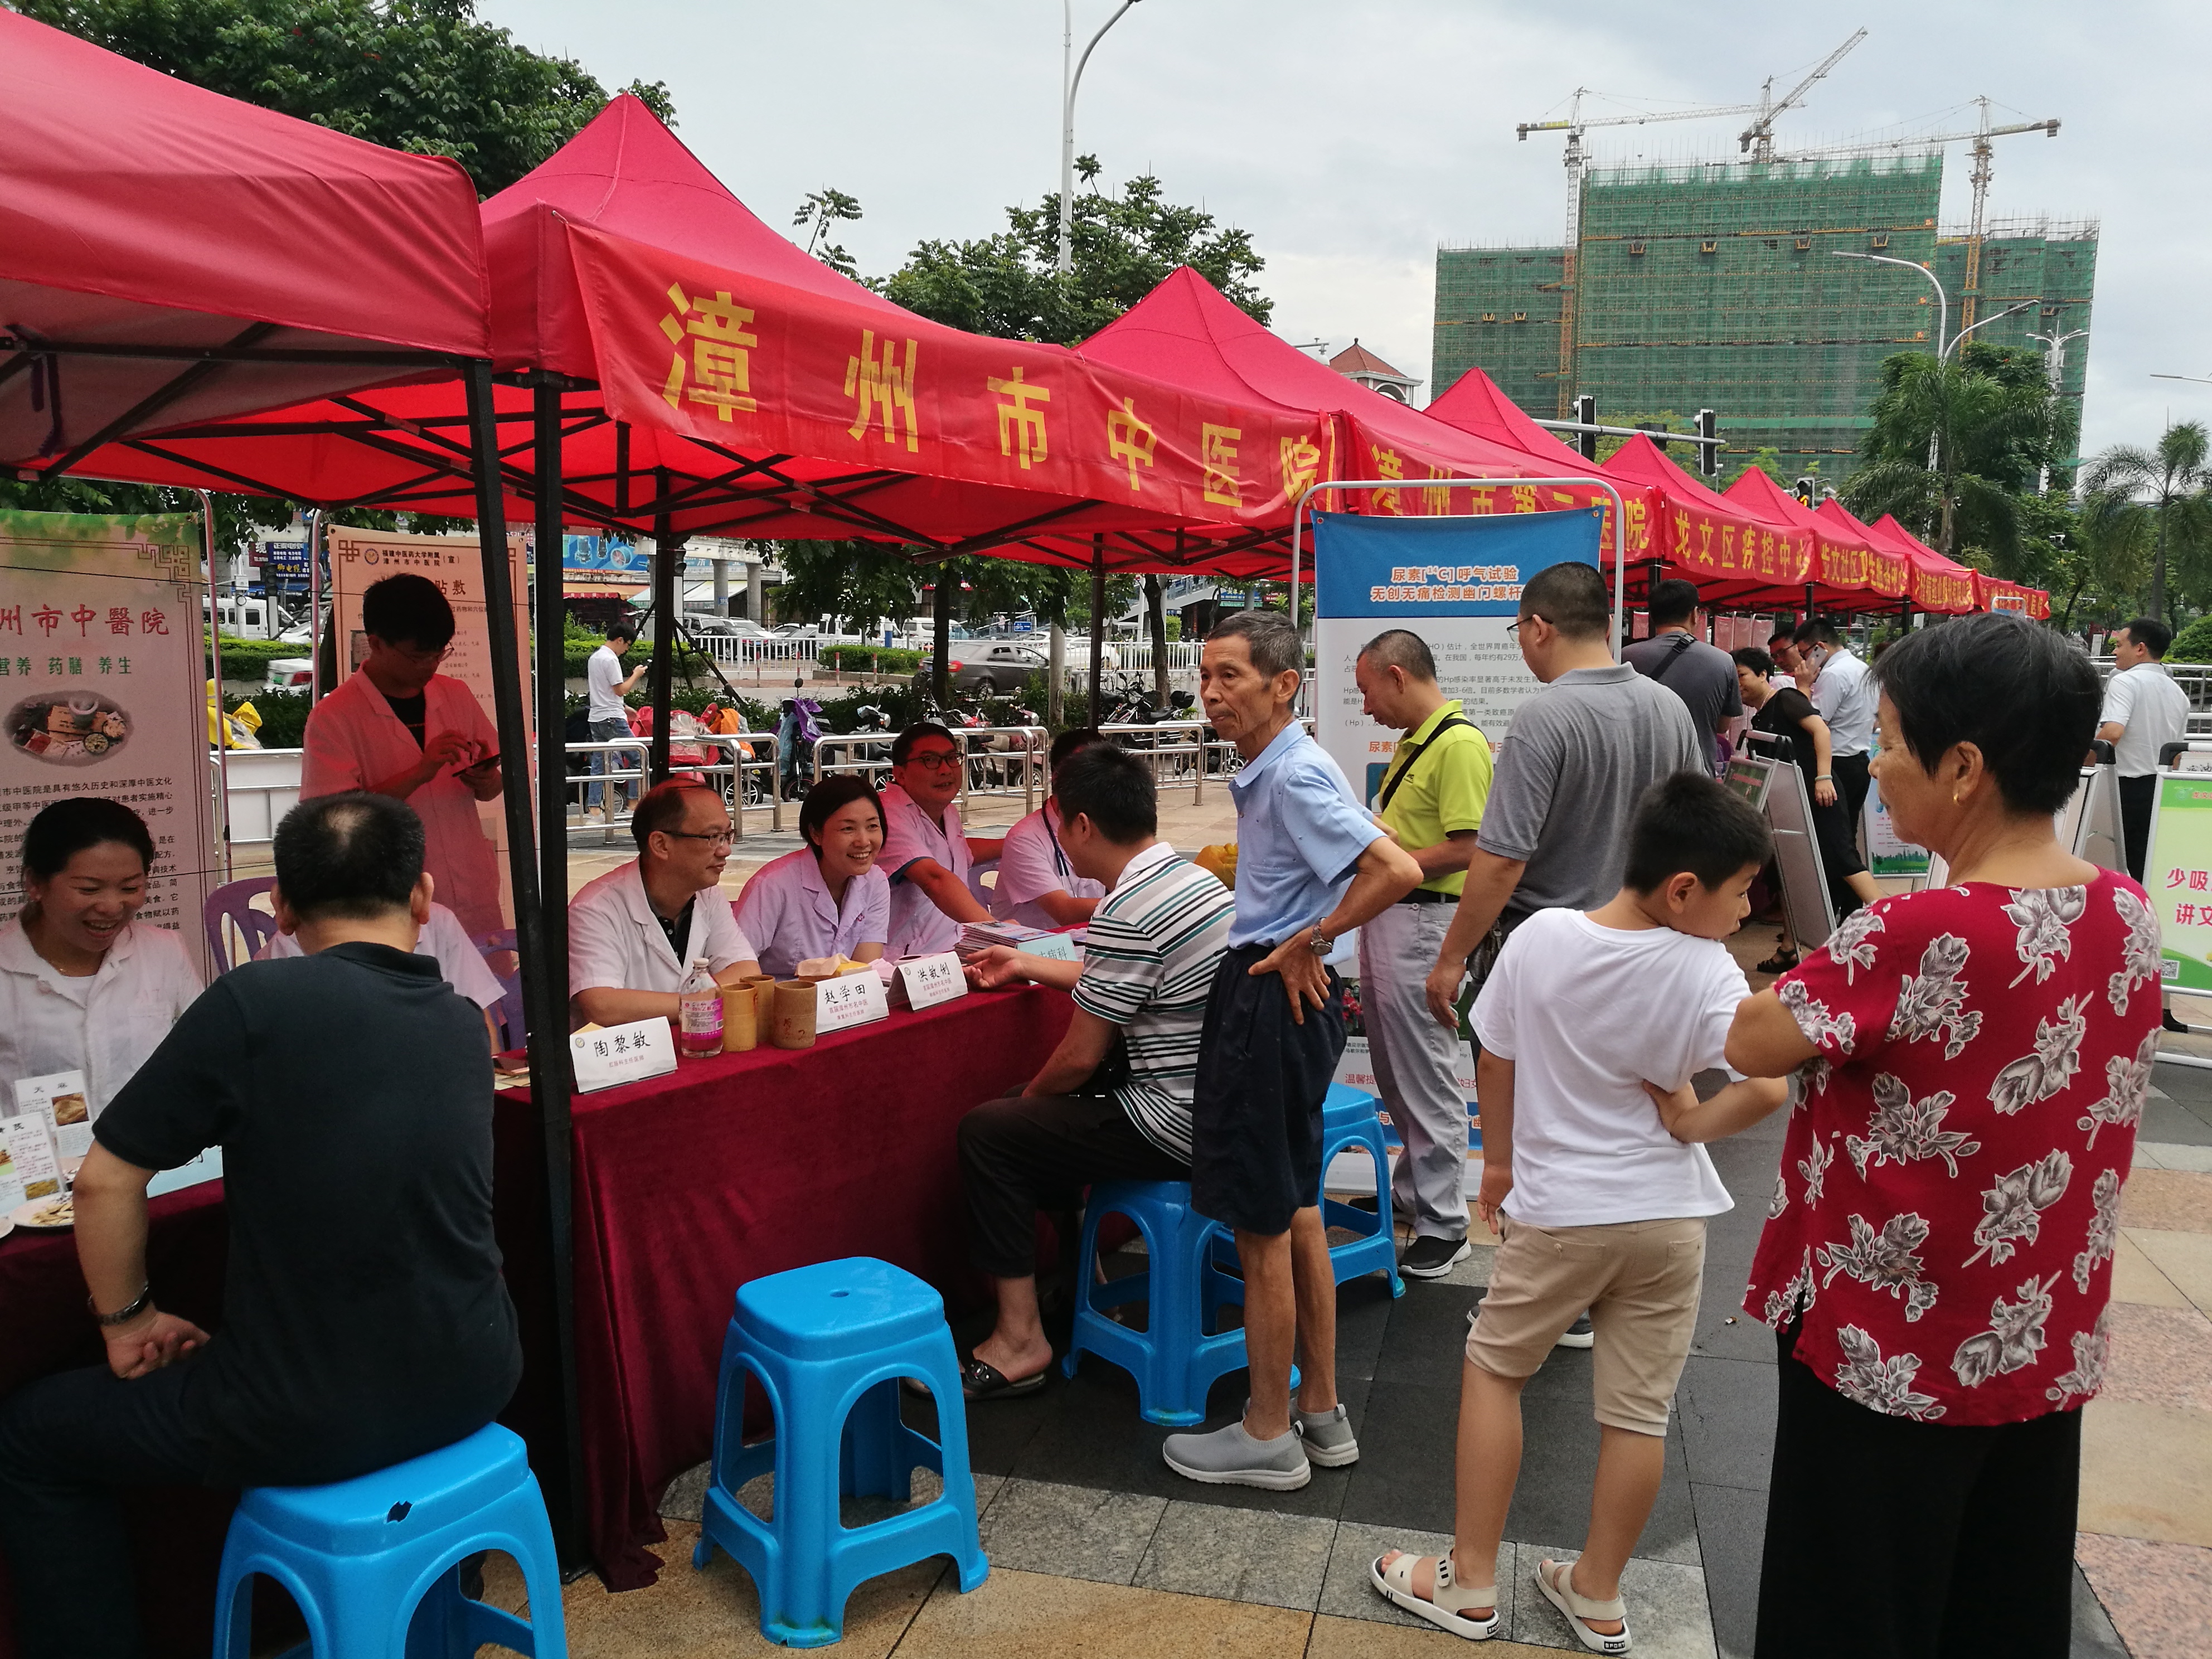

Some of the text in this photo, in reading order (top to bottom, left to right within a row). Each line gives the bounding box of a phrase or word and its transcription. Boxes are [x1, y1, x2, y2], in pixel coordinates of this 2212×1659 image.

[659, 282, 1321, 508] 漳州市中医院
[1675, 508, 1811, 577] 龙文区疾控中心
[384, 558, 440, 566] 漳州市中医院
[48, 657, 83, 675] 药膳
[98, 656, 132, 675] 养生
[0, 777, 172, 796] 市中医院是具有悠久历史和深厚中医文化
[159, 836, 175, 845] 是在
[824, 984, 866, 1005] 赵学田
[593, 1030, 651, 1058] 陶黎敏
